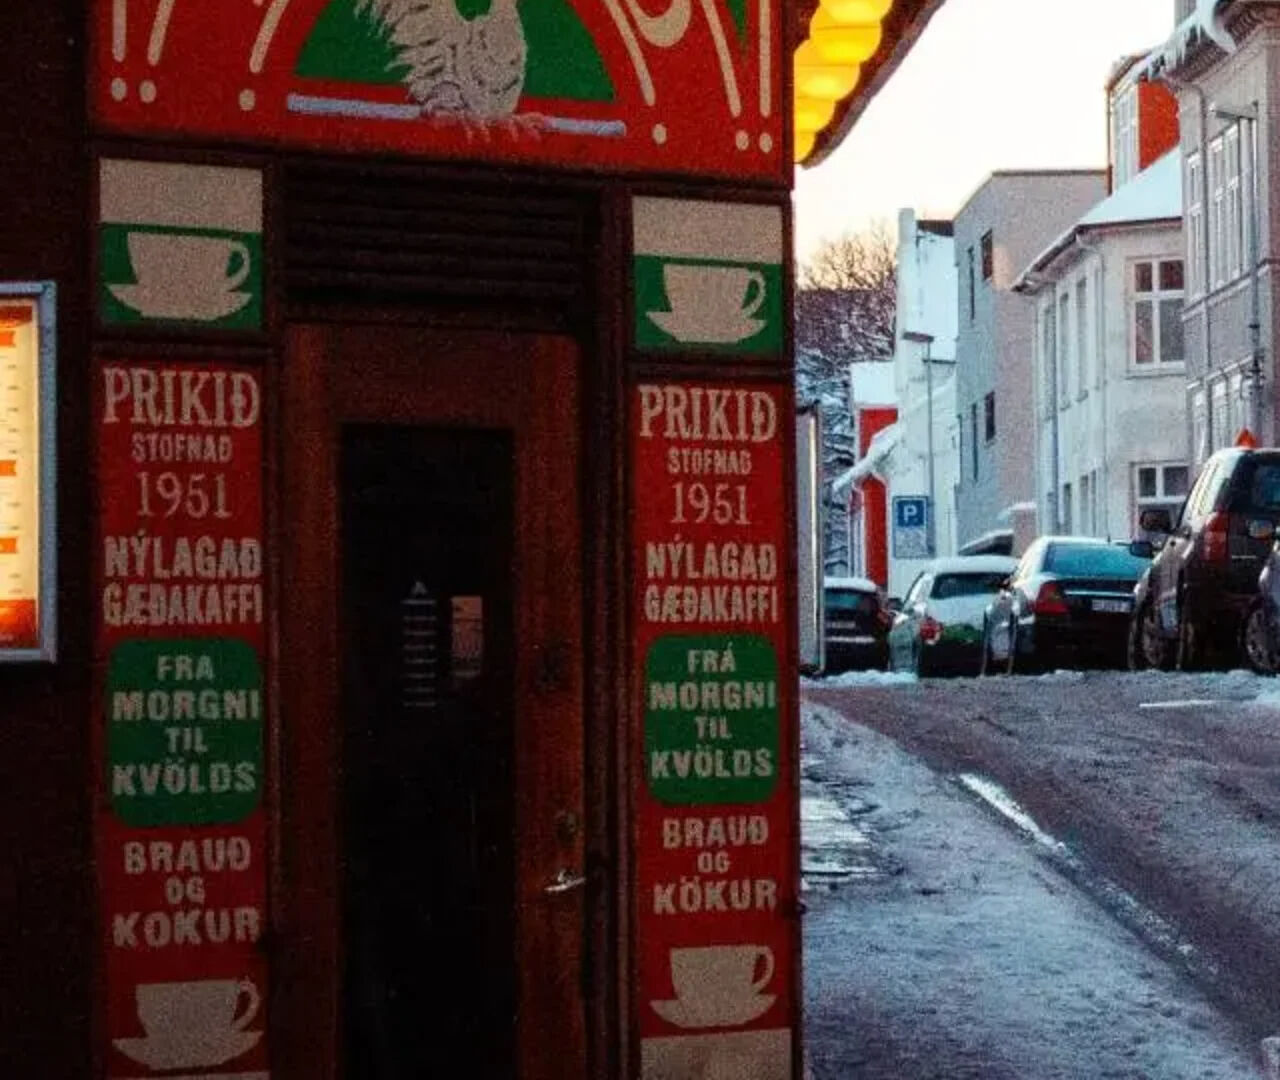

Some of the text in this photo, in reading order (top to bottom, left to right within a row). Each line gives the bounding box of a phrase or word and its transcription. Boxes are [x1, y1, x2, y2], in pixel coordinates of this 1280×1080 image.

[102, 366, 261, 428] PRIKIÐ
[637, 384, 777, 443] PRIKIÐ
[135, 470, 233, 519] 1951
[669, 481, 752, 526] 1951
[903, 504, 918, 523] P
[103, 527, 263, 580] NÝLAGAÐ
[645, 532, 777, 582] NÝLAGAÐ
[102, 581, 264, 627] GÆÐAKAFFI
[644, 583, 779, 624] GÆÐAKAFFI
[687, 640, 737, 674] FRÁ
[112, 688, 261, 722] MORGNI
[649, 680, 777, 711] MORGNI
[163, 726, 209, 754] TIL
[693, 715, 733, 740] TIL
[111, 756, 257, 797] KVÖLDS
[650, 743, 774, 779] KVÖLDS
[661, 813, 770, 850] BRAUÐ
[122, 834, 252, 875] BRAUÐ
[696, 850, 733, 875] OG
[164, 875, 207, 906] OG
[653, 874, 778, 916] KÖKUR
